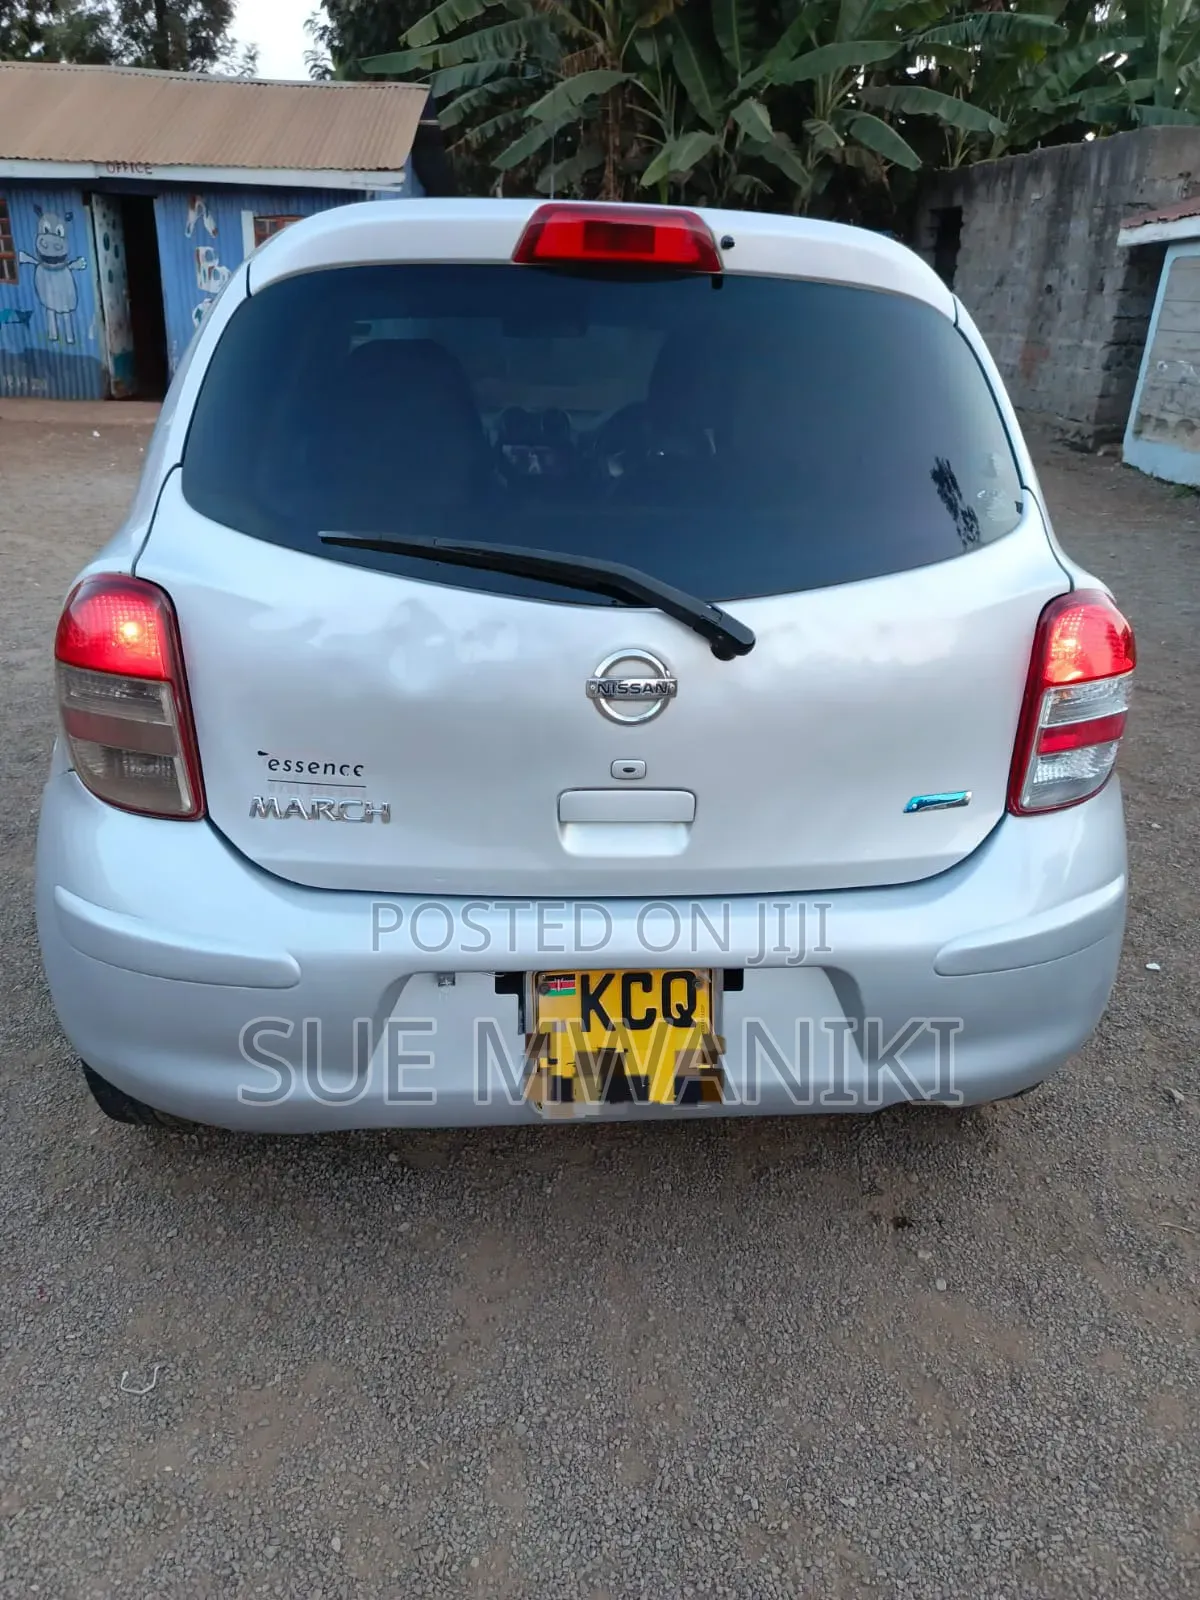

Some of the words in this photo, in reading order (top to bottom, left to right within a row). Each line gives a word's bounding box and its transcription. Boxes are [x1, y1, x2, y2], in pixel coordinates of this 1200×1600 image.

[106, 161, 153, 175] OFFICE
[597, 682, 668, 695] NISSAN
[249, 796, 391, 824] MARCH
[580, 970, 698, 1033] KCQ
